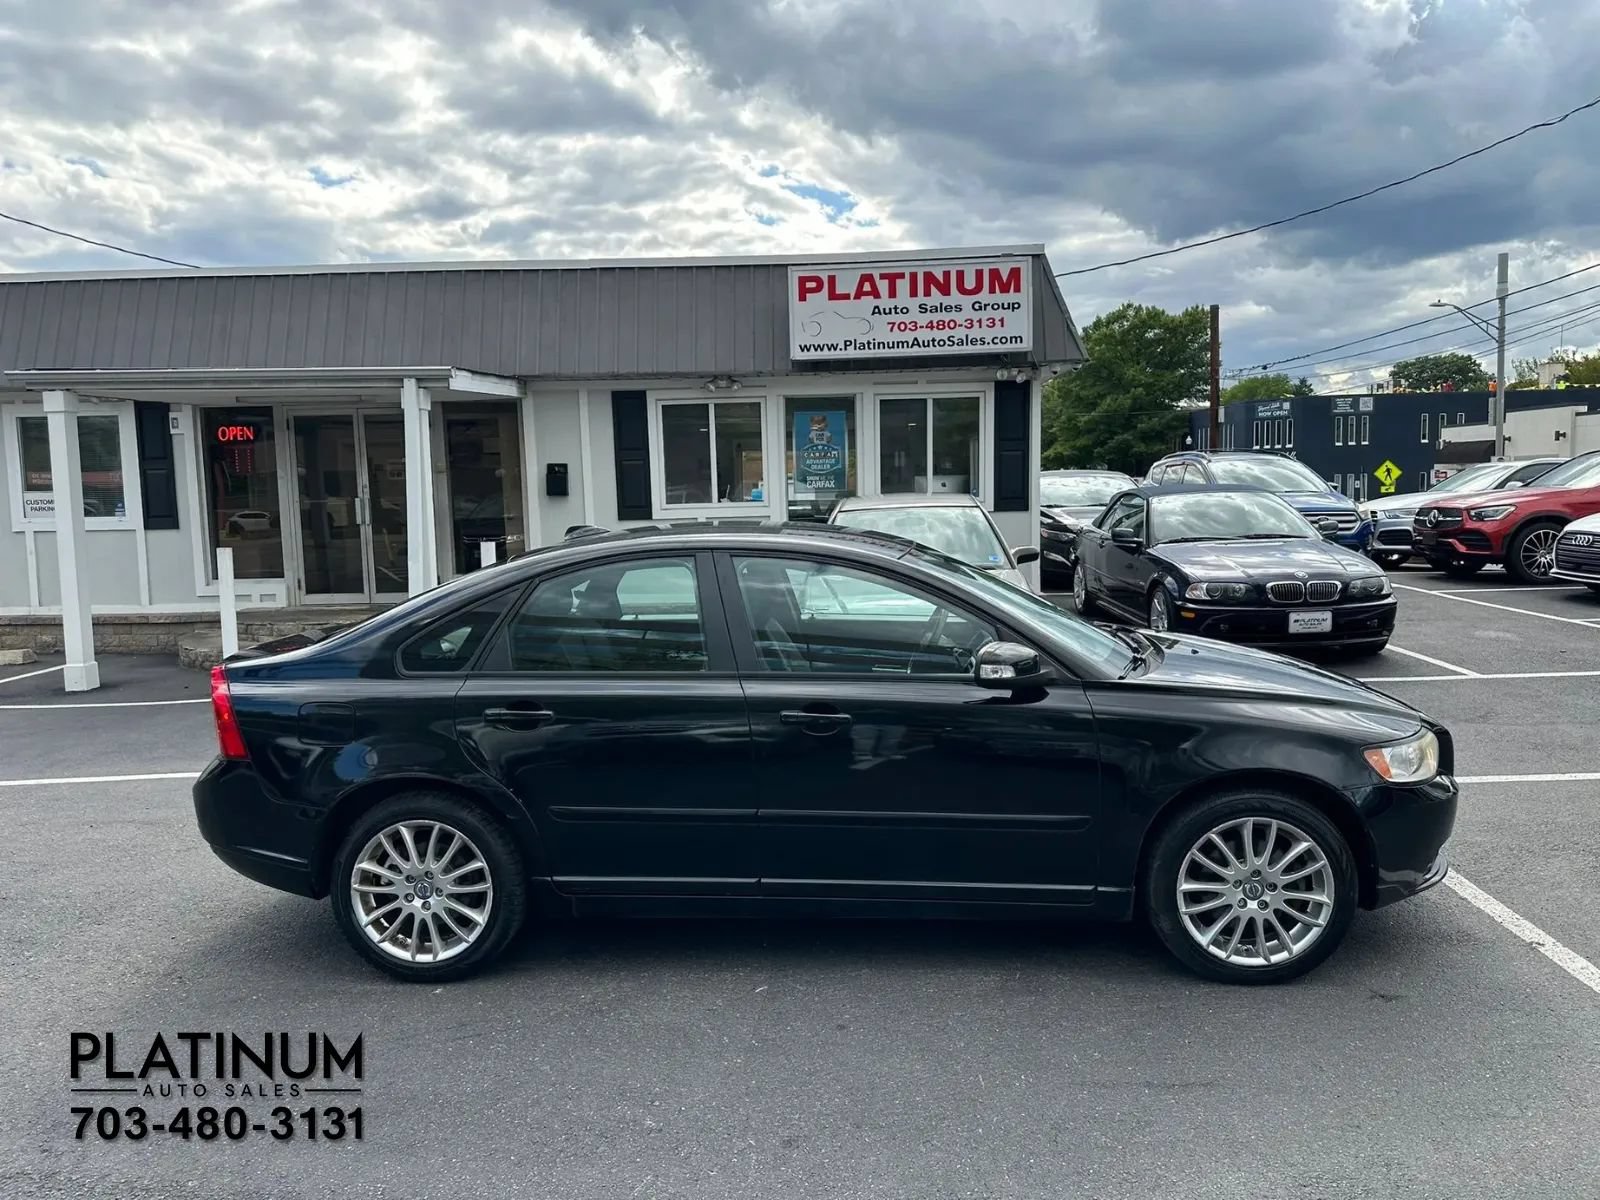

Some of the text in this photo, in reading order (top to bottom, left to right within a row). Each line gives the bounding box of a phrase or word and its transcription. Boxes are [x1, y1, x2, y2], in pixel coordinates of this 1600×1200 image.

[797, 267, 1022, 302] PLATINUM
[871, 300, 1022, 316] Auto Sales Group
[886, 317, 1006, 333] 703-480-3131
[798, 335, 1024, 353] www.PlatinumAutoSales.com
[217, 426, 254, 441] OPEN
[806, 480, 835, 489] CARFAX
